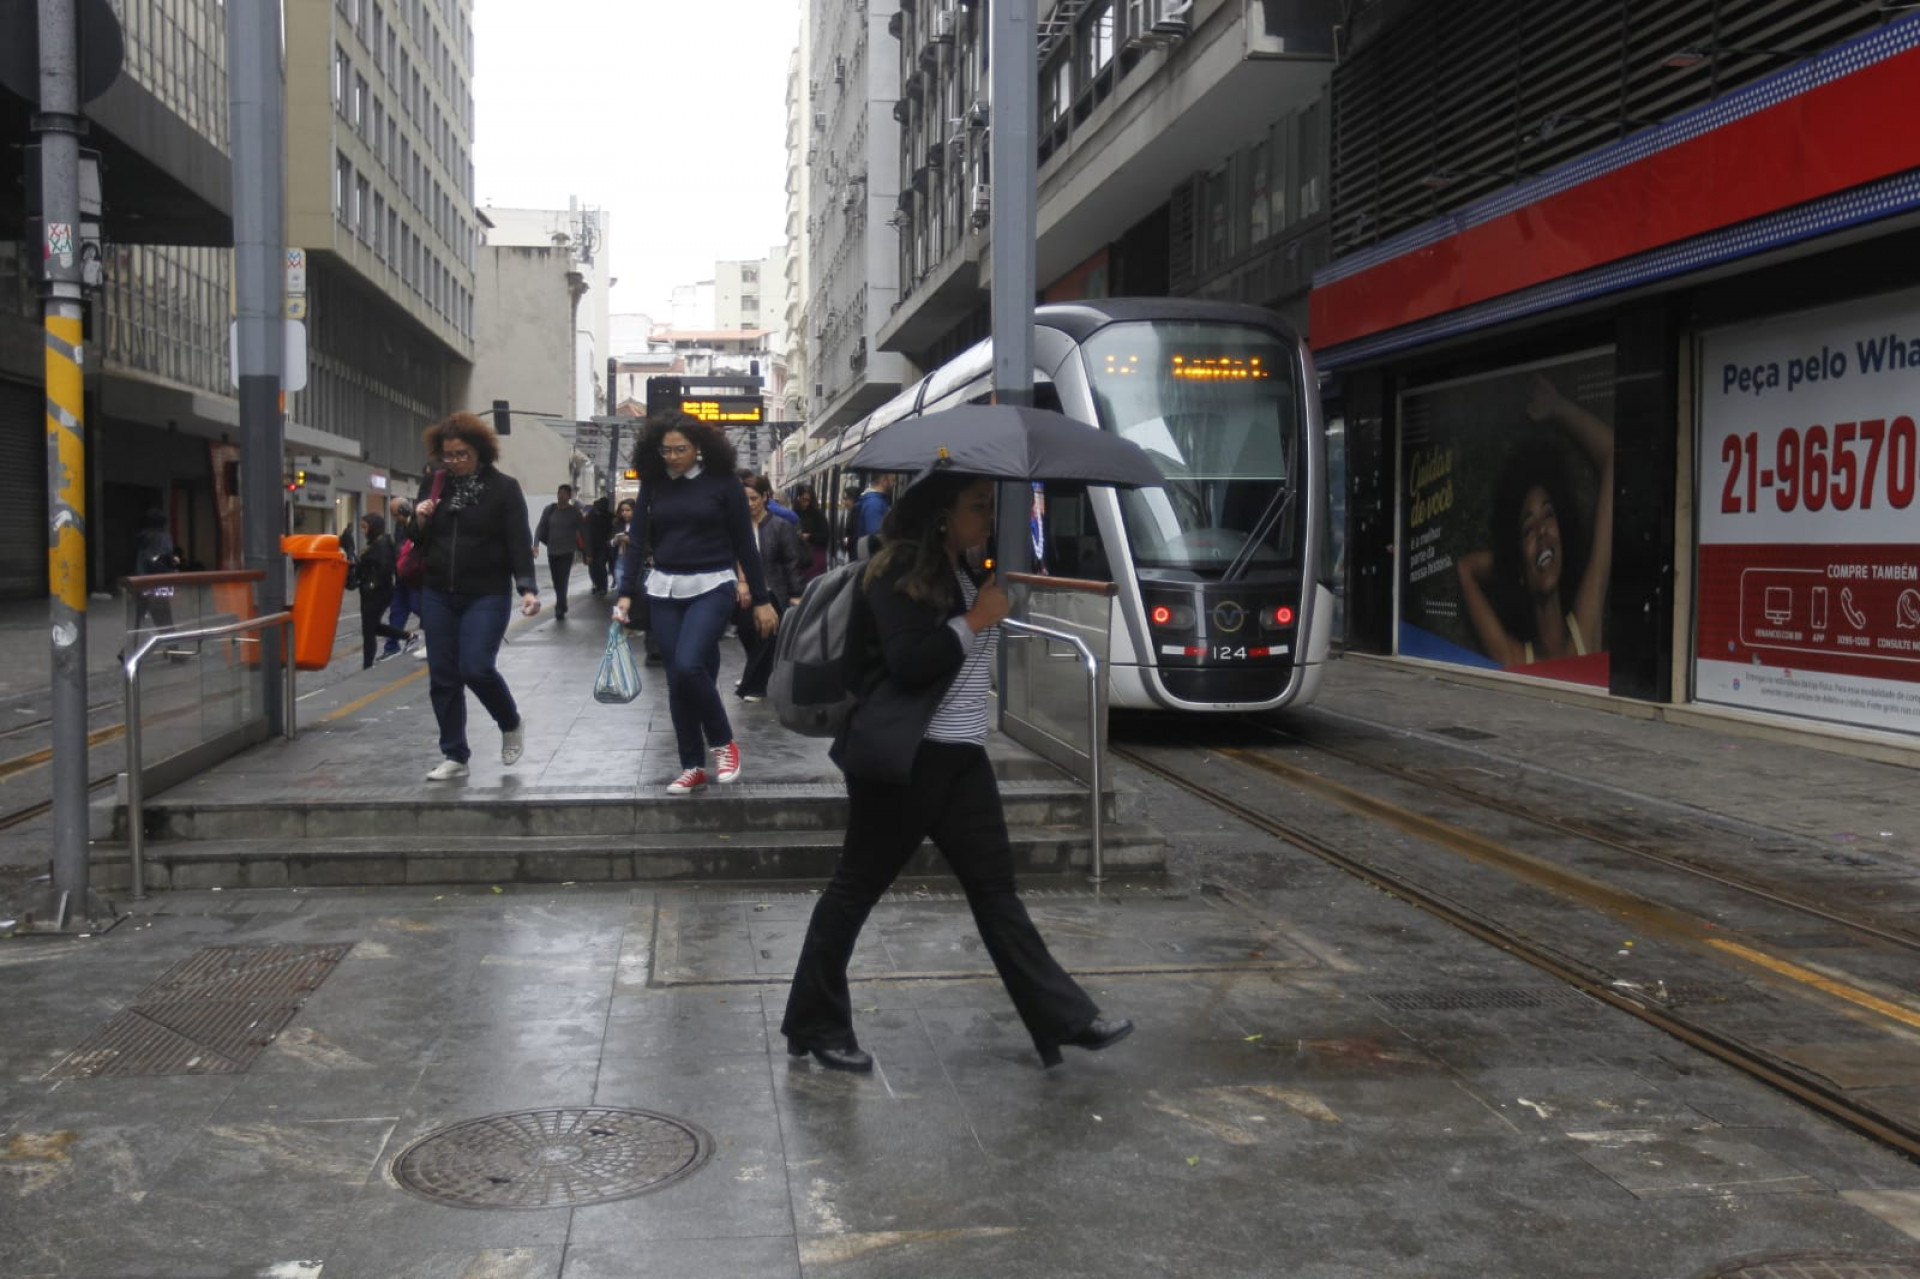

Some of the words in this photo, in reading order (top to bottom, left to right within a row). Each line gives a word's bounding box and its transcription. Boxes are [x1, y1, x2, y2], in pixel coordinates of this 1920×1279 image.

[1723, 362, 1780, 396] Peça
[1788, 346, 1847, 392] pelo
[1721, 415, 1917, 515] 21-96570
[1827, 564, 1869, 579] COMPRE
[1871, 561, 1918, 581] TAMBÉM
[1213, 645, 1247, 660] 124
